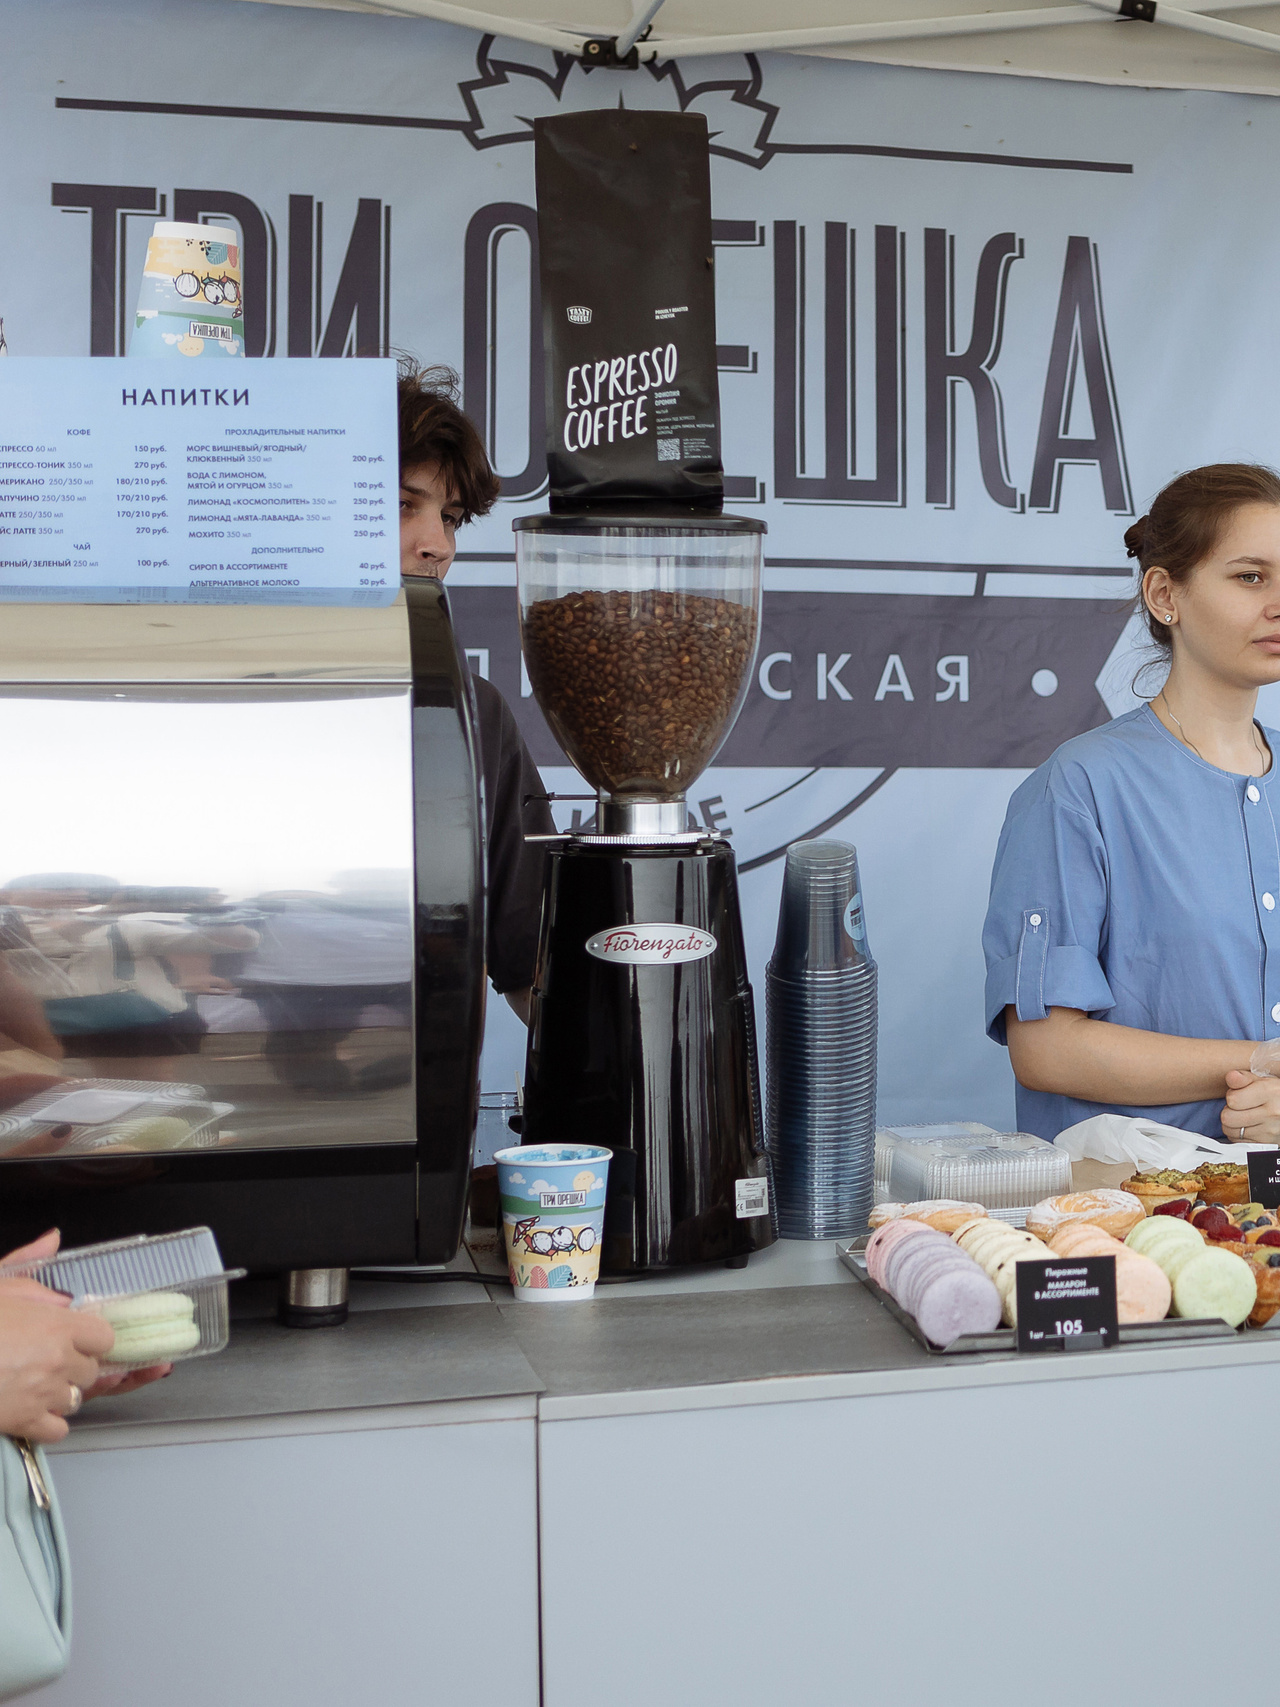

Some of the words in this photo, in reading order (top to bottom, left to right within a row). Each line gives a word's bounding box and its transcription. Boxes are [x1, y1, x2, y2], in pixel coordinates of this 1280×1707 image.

[463, 202, 1137, 517] ОЕШКА
[566, 343, 678, 409] ESPRESSO
[122, 388, 249, 406] НАПИТКИ
[564, 396, 648, 452] COFFEE
[150, 446, 167, 454] руб.
[186, 454, 245, 463] КЛЮКВЕННЫЙ
[368, 456, 385, 464] руб.
[150, 462, 167, 470] руб.
[187, 472, 210, 480] ВОДА
[218, 472, 267, 480] ЛИМОНОМ,
[49, 478, 82, 486] 250/350
[116, 478, 149, 486] 180/210
[151, 478, 167, 487] руб.
[188, 481, 217, 489] МЯТОЙ
[226, 482, 266, 490] ОГУРЦОМ
[369, 482, 386, 491] руб.
[42, 495, 75, 503] 250/350
[116, 494, 150, 502] 170/210
[152, 494, 168, 503] руб.
[188, 498, 231, 506] ЛИМОНАД
[232, 498, 310, 506] «КОСМОПОЛИТЕН»
[370, 498, 386, 507] руб.
[18, 510, 52, 519] 250/350
[117, 510, 150, 518] 170/210
[152, 510, 169, 519] руб.
[188, 515, 232, 523] ЛИМОНАД
[233, 514, 304, 523] «МЯТА-ЛАВАНДА»
[370, 514, 386, 523] руб.
[0, 526, 11, 535] ЙС
[152, 527, 169, 536] руб.
[370, 530, 386, 539] руб.
[73, 542, 91, 550] ЧАЙ
[251, 547, 325, 555] ДОПОЛНИТЕЛЬНО
[0, 560, 71, 568] ЕРНЫЙ/ЗЕЛЕНЫЙ
[73, 560, 87, 568] 250
[154, 560, 170, 569] руб.
[226, 563, 288, 571] АССОРТИМЕНТЕ
[370, 562, 387, 571] руб.
[262, 579, 300, 587] МОЛОКО
[360, 578, 369, 586] 50
[370, 579, 387, 588] руб.
[604, 931, 703, 959] Fiorenzato
[542, 1194, 556, 1206] ТРИ
[558, 1193, 584, 1206] ОРЕШКА
[1045, 1268, 1088, 1278] Пирожные
[1048, 1280, 1087, 1290] МАКАРОН
[1034, 1290, 1040, 1300] В
[1041, 1287, 1099, 1299] АССОРТИМЕНТЕ
[1056, 1320, 1083, 1336] 105
